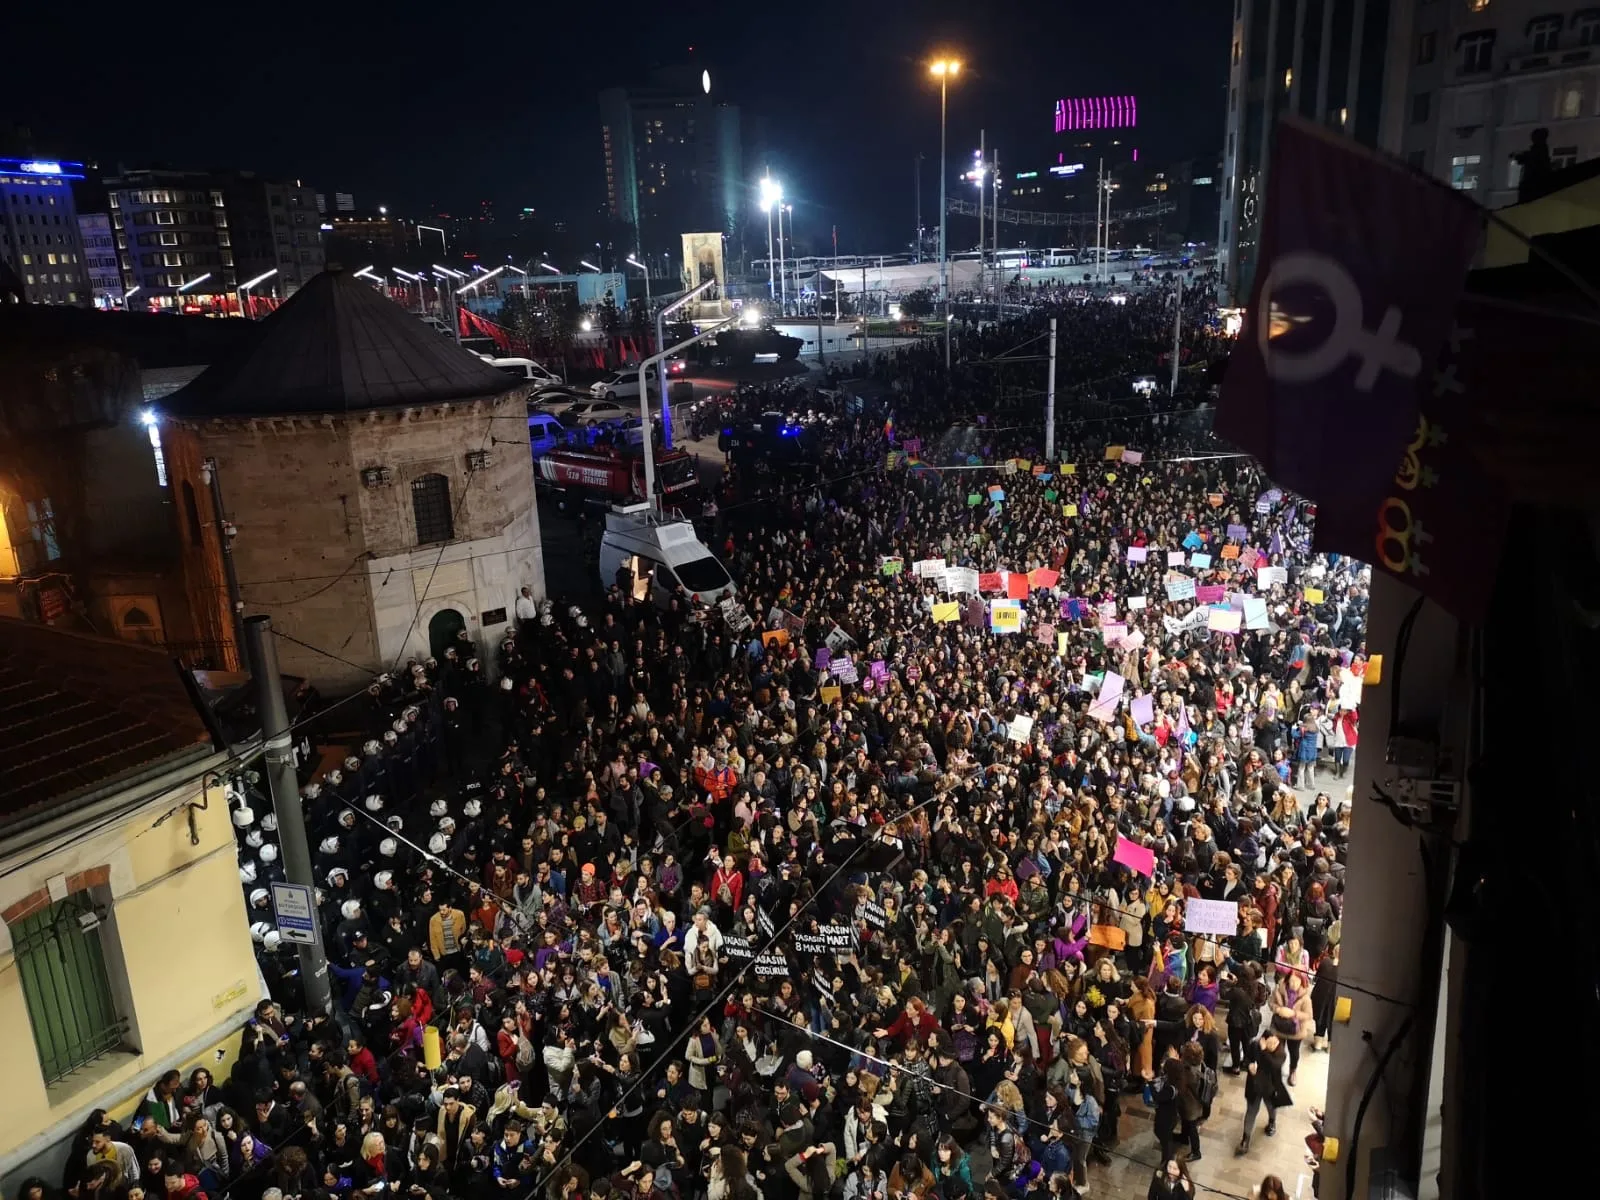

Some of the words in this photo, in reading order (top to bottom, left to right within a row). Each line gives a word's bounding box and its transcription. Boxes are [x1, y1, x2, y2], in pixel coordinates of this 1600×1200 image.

[826, 935, 849, 946] MART
[795, 941, 802, 952] 8
[802, 943, 826, 954] MART
